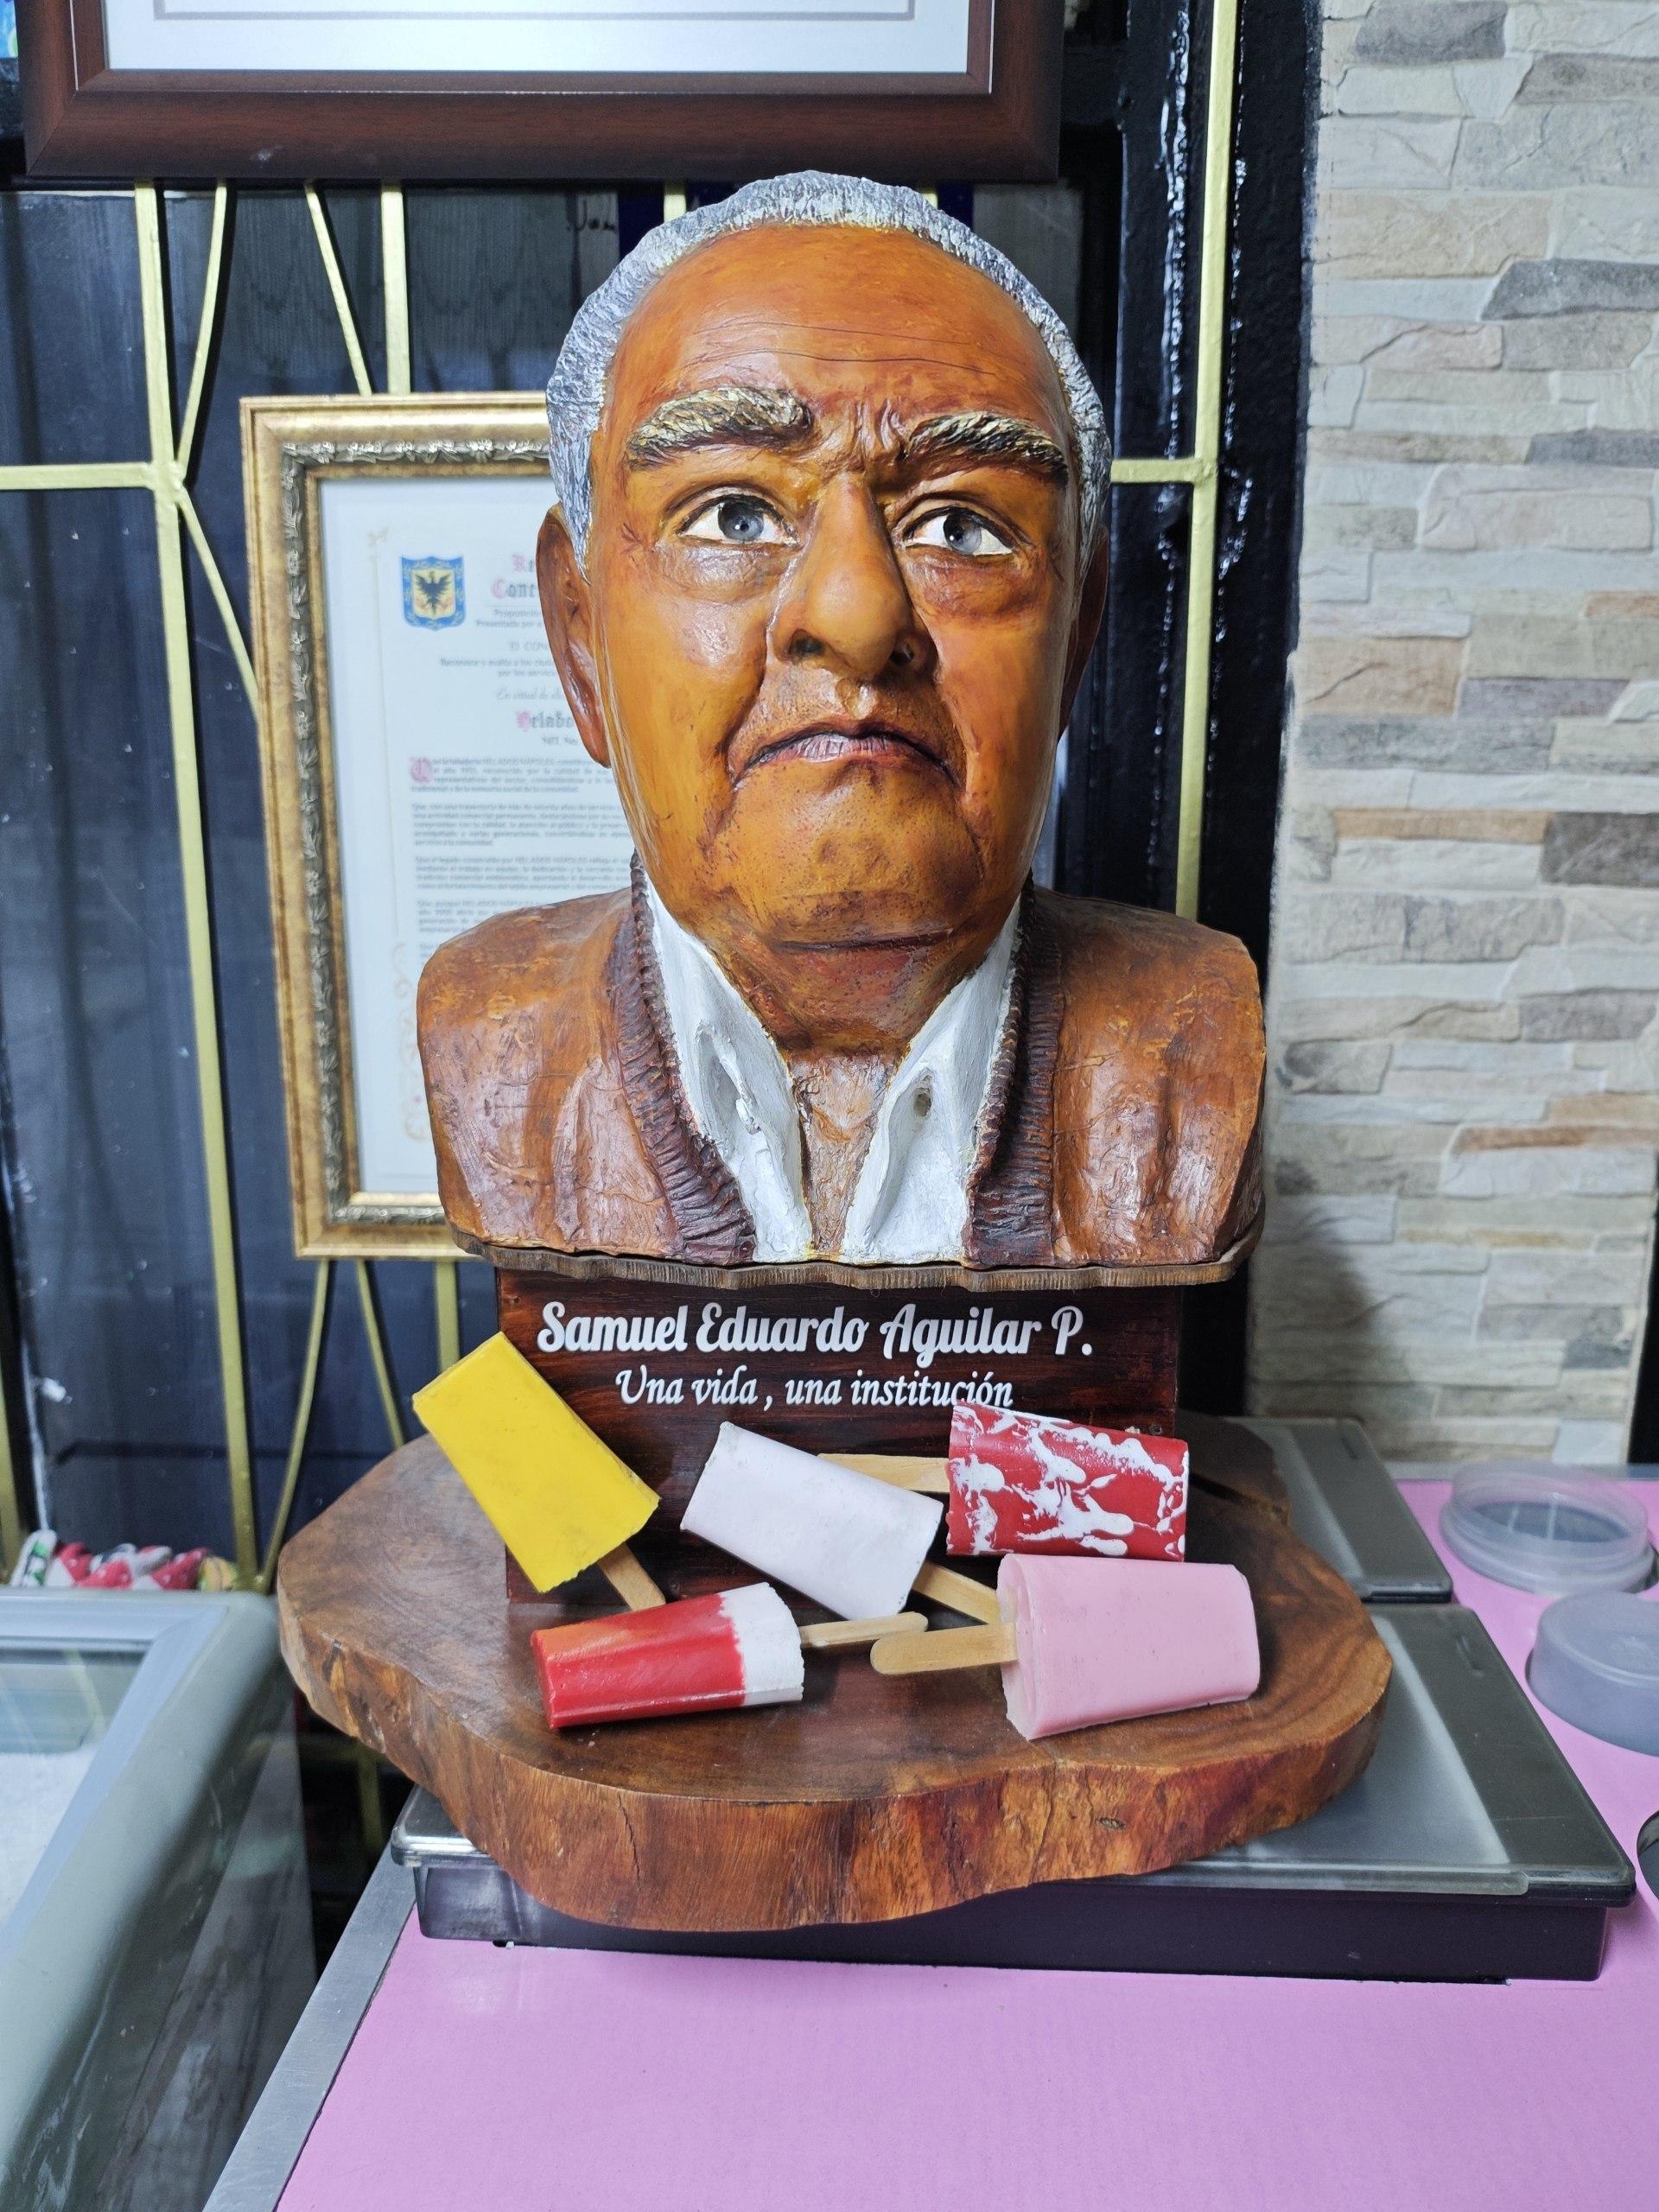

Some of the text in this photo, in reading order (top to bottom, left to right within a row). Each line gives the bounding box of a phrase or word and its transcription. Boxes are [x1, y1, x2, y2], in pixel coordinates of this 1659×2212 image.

[537, 1301, 1092, 1369] Samuel Eduardo Aguilar P.
[615, 1364, 684, 1405] Una
[785, 1379, 842, 1405] una
[850, 1369, 1014, 1408] institución
